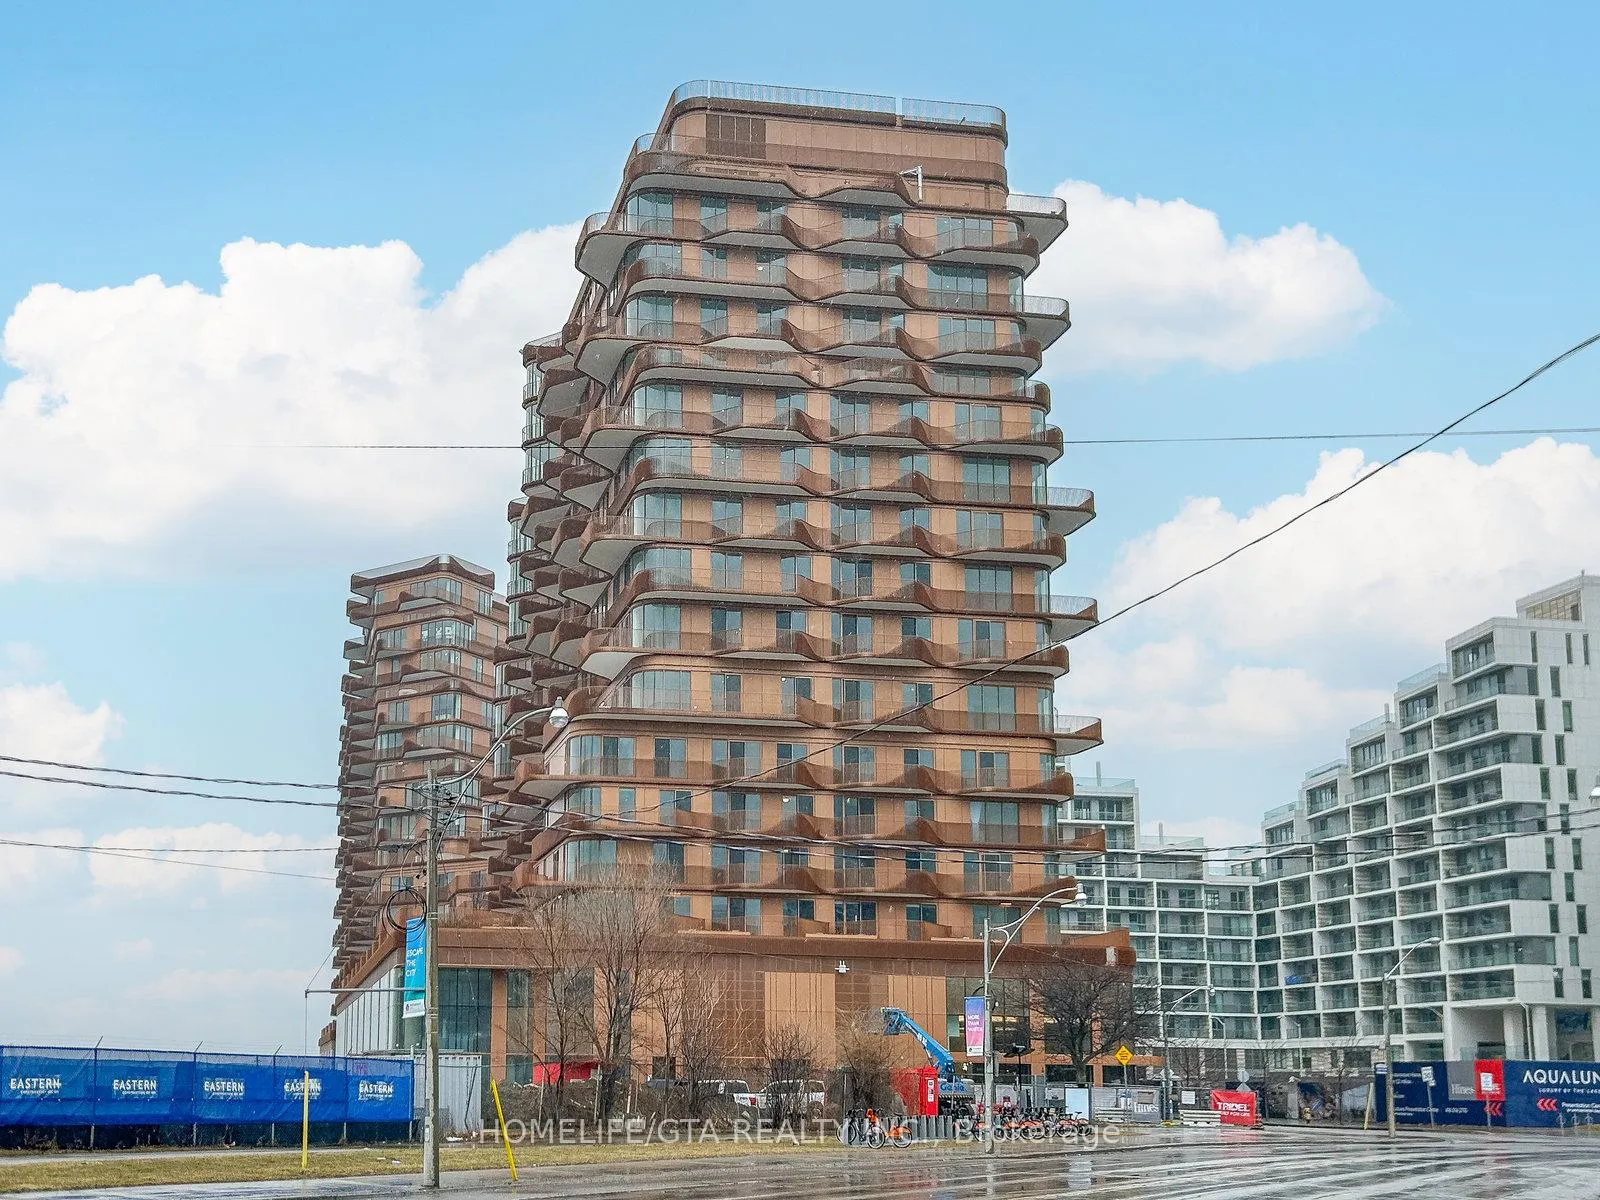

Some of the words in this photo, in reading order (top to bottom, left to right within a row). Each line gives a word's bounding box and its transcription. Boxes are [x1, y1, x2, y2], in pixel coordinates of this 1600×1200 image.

[406, 947, 424, 957] ESCAPE
[405, 969, 416, 977] CITY
[10, 1078, 60, 1089] EASTERN
[113, 1080, 157, 1090] EASTERN
[204, 1081, 244, 1092] EASTERN
[359, 1083, 393, 1093] EASTERN
